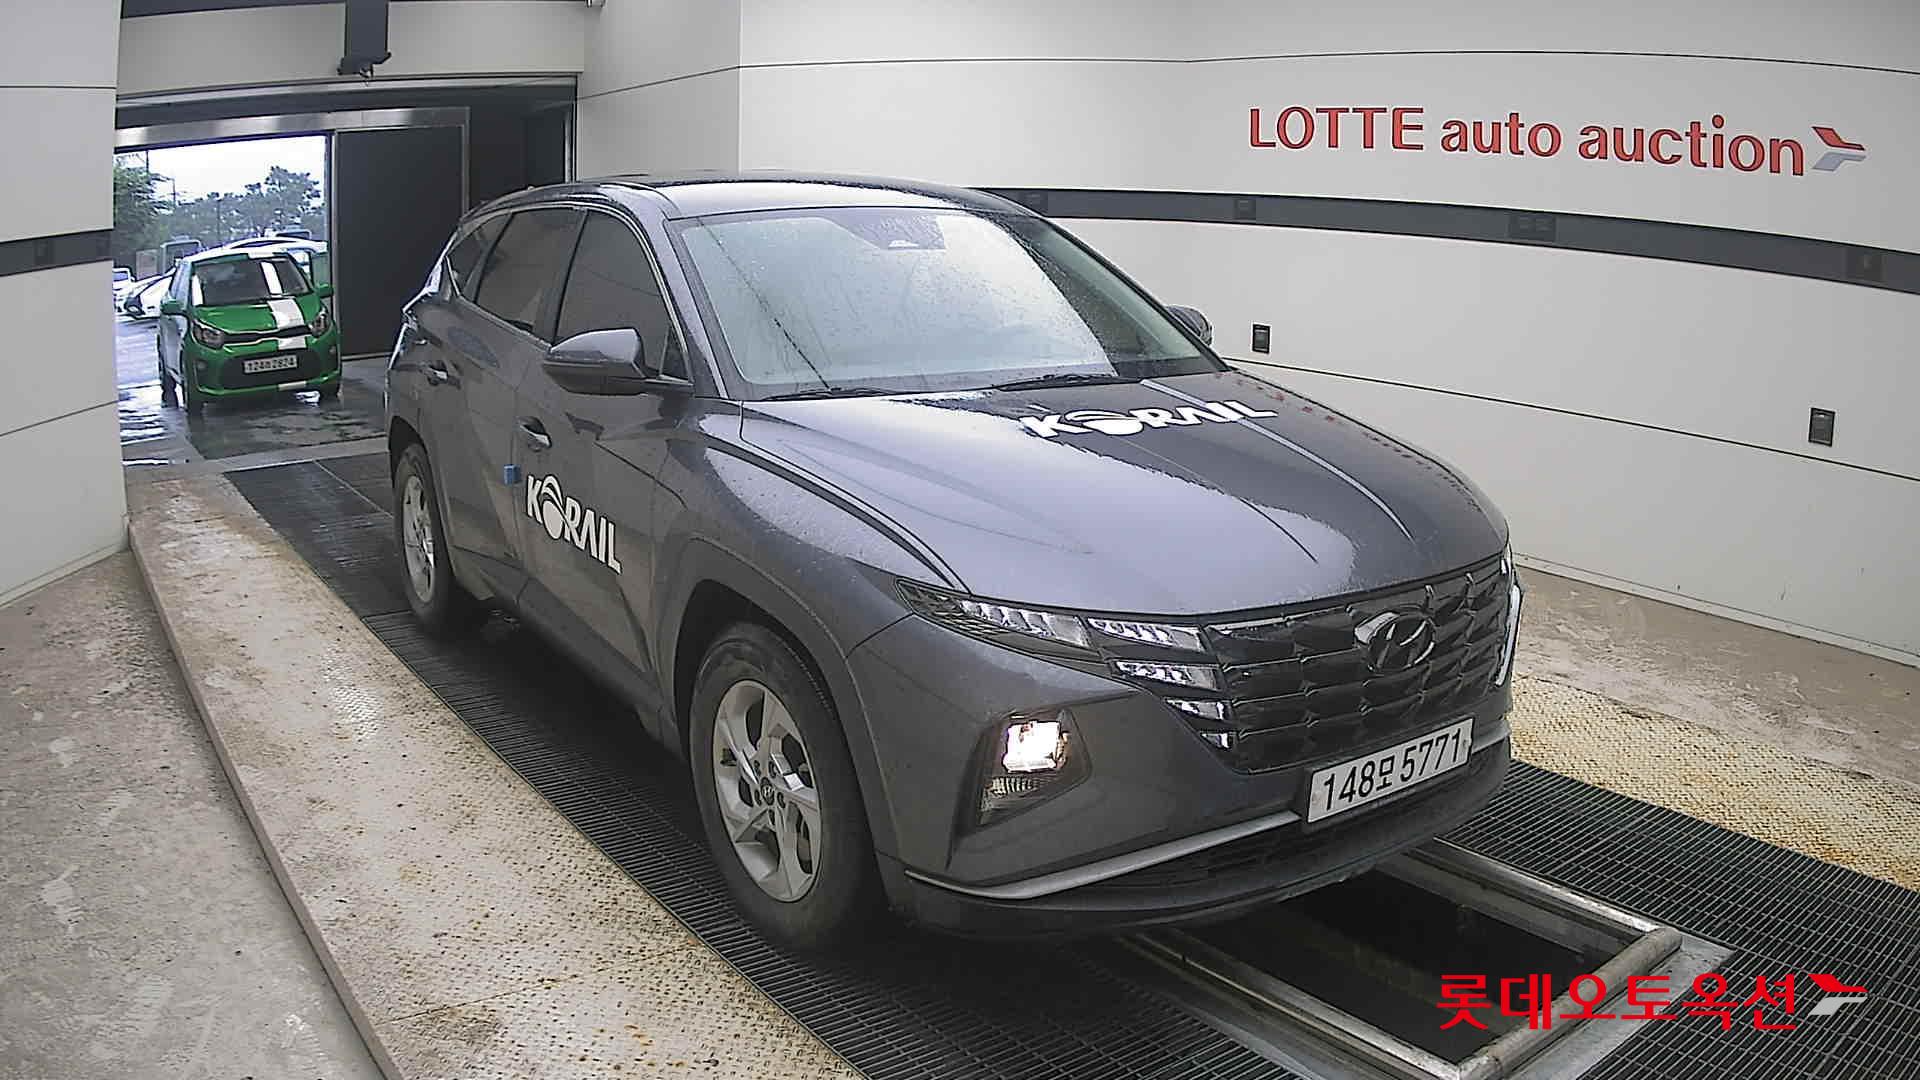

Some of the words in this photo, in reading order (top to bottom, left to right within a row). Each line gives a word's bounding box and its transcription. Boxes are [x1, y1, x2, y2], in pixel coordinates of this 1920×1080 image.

[1249, 106, 1424, 150] LOTTE
[1440, 111, 1562, 157] auto
[1578, 114, 1804, 176] auction
[1019, 400, 1279, 438] KORAIL
[527, 474, 622, 574] KORAIL
